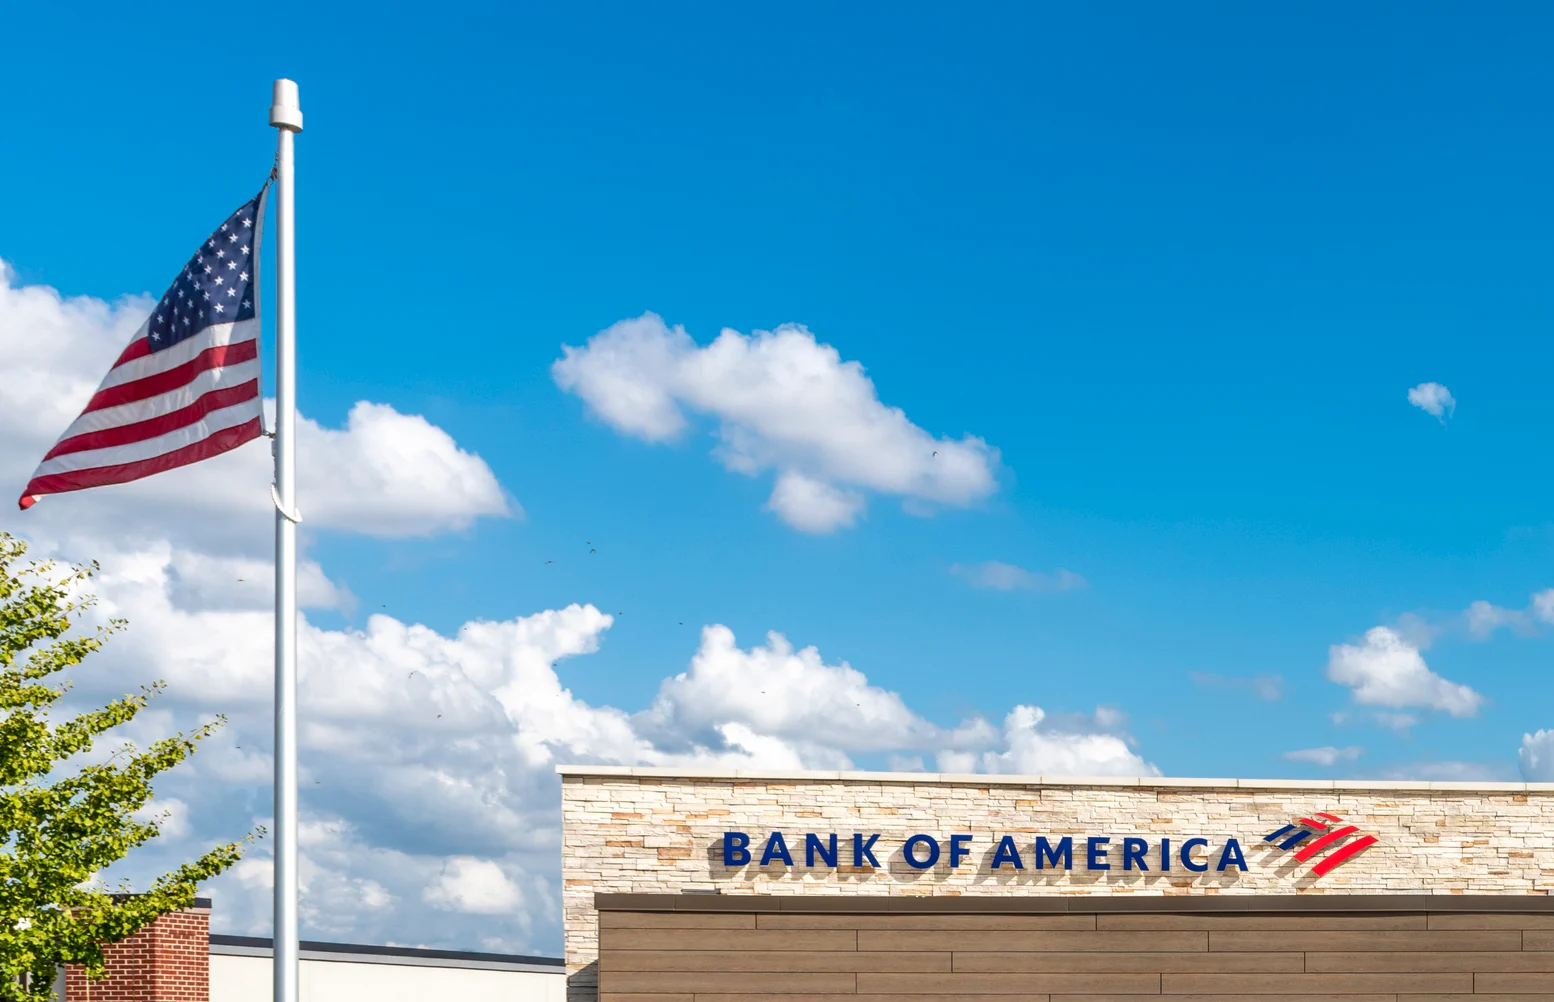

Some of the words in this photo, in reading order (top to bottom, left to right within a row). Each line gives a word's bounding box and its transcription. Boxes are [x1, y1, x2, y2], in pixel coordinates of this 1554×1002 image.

[723, 831, 880, 867] BANK
[903, 834, 973, 869] OF
[992, 836, 1248, 871] AMERICA
